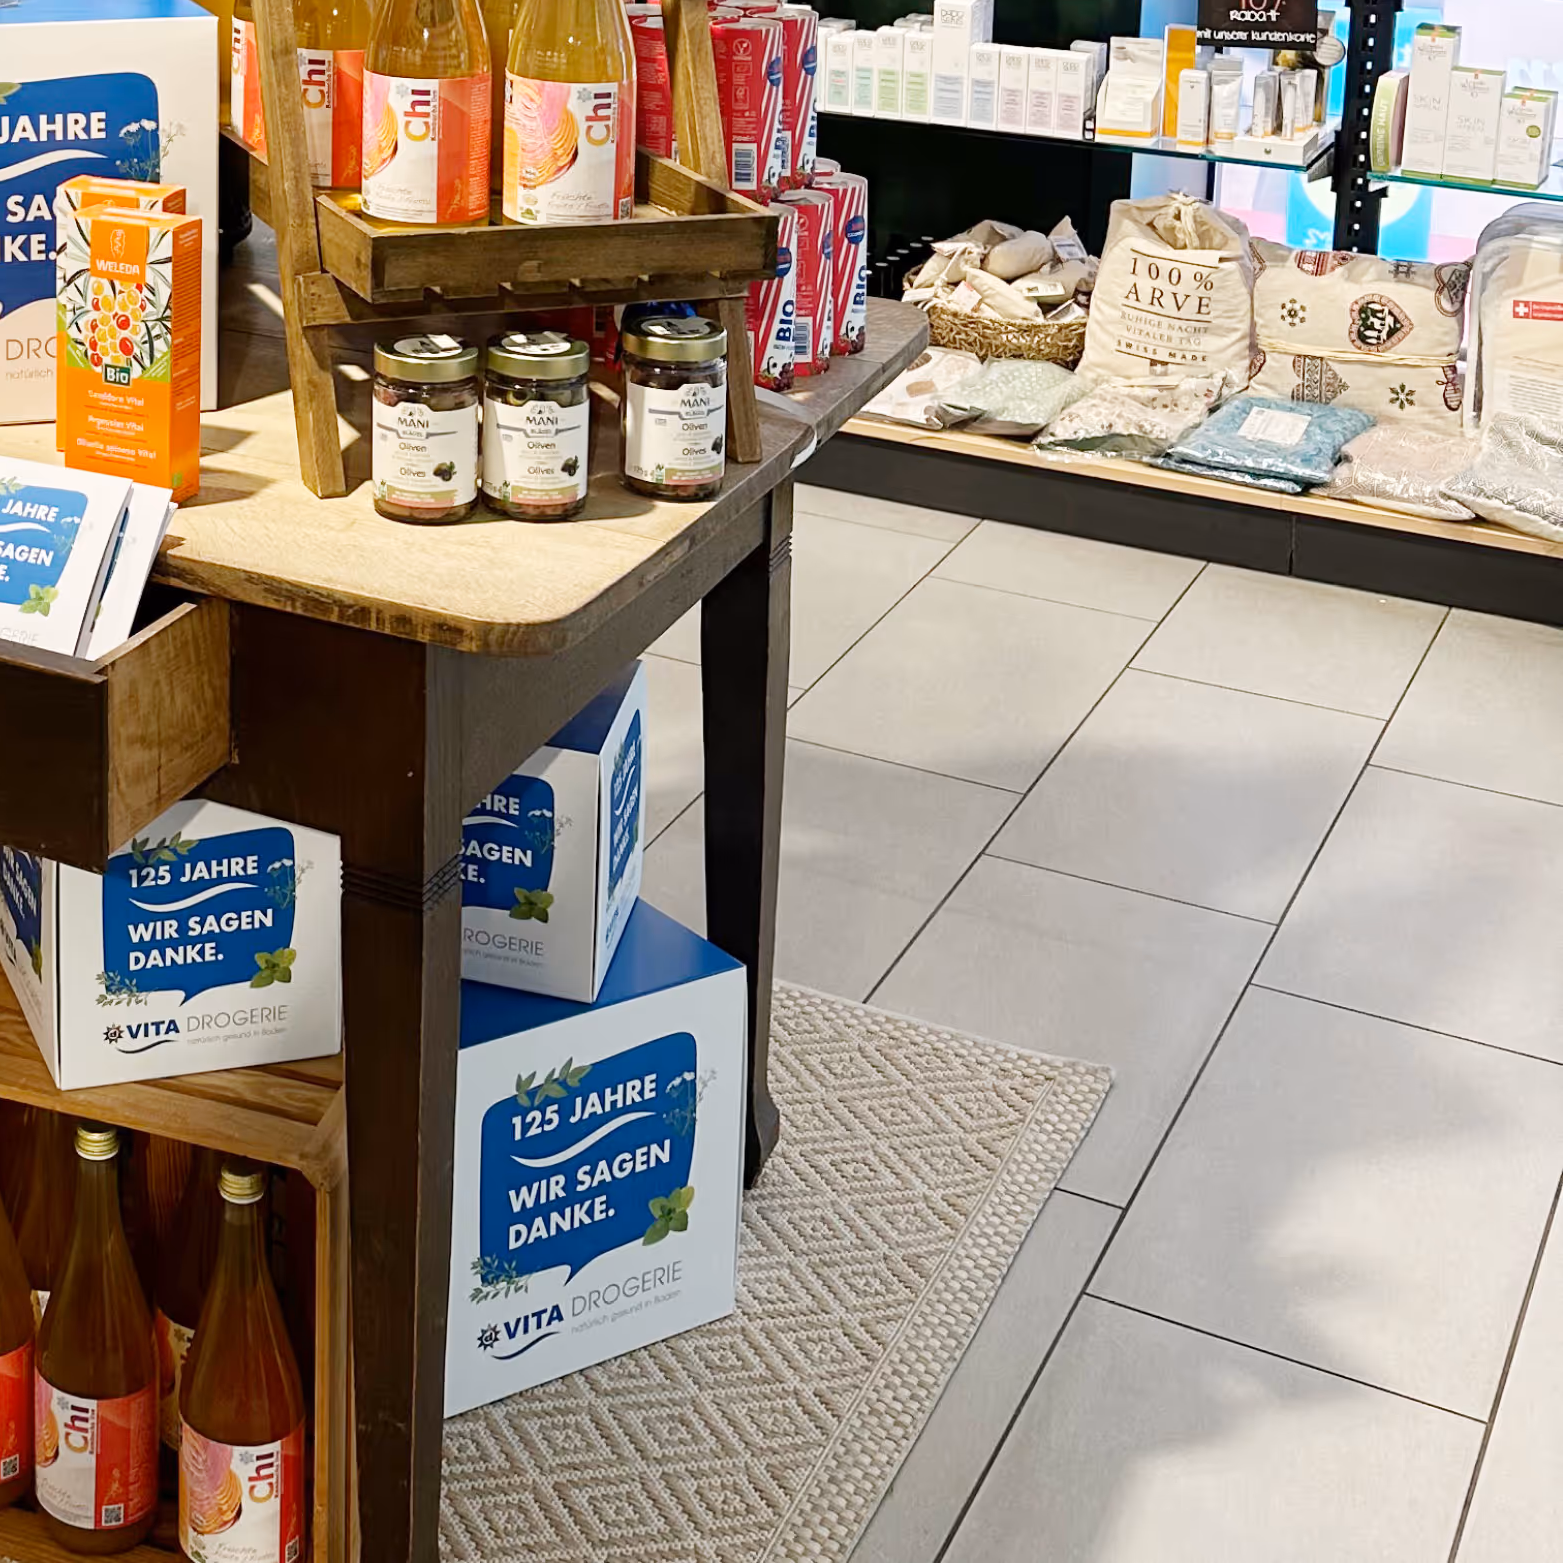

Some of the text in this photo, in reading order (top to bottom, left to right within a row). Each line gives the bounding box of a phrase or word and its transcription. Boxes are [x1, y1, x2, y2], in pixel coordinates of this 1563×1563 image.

[1229, 9, 1280, 22] Rabatt
[302, 58, 326, 110] Chi
[404, 89, 431, 142] Chi
[585, 92, 612, 146] Chi
[95, 259, 140, 276] WELEDA
[1124, 282, 1212, 316] ARVE
[1120, 310, 1209, 334] RUHIGE NACHT
[1126, 325, 1202, 346] VITALER TAG
[1117, 338, 1207, 362] SWISS MADE
[106, 367, 129, 384] Bio
[680, 397, 711, 409] MANI
[398, 417, 430, 428] MANI
[526, 416, 559, 426] MANI
[1, 499, 60, 523] JAHRE
[128, 855, 260, 889] 125 JAHRE
[127, 908, 274, 944] WIR SAGEN
[462, 926, 545, 957] ROGERIE
[128, 942, 225, 971] DANKE.
[126, 1004, 290, 1040] VITA DROGERIE
[511, 1073, 658, 1141] 125 JAHRE
[508, 1138, 672, 1214] WIR SAGEN
[508, 1195, 616, 1251] DANKE.
[503, 1260, 683, 1340] VITA DROGERIE
[64, 1404, 90, 1454] Chi
[248, 1451, 275, 1504] Chi
